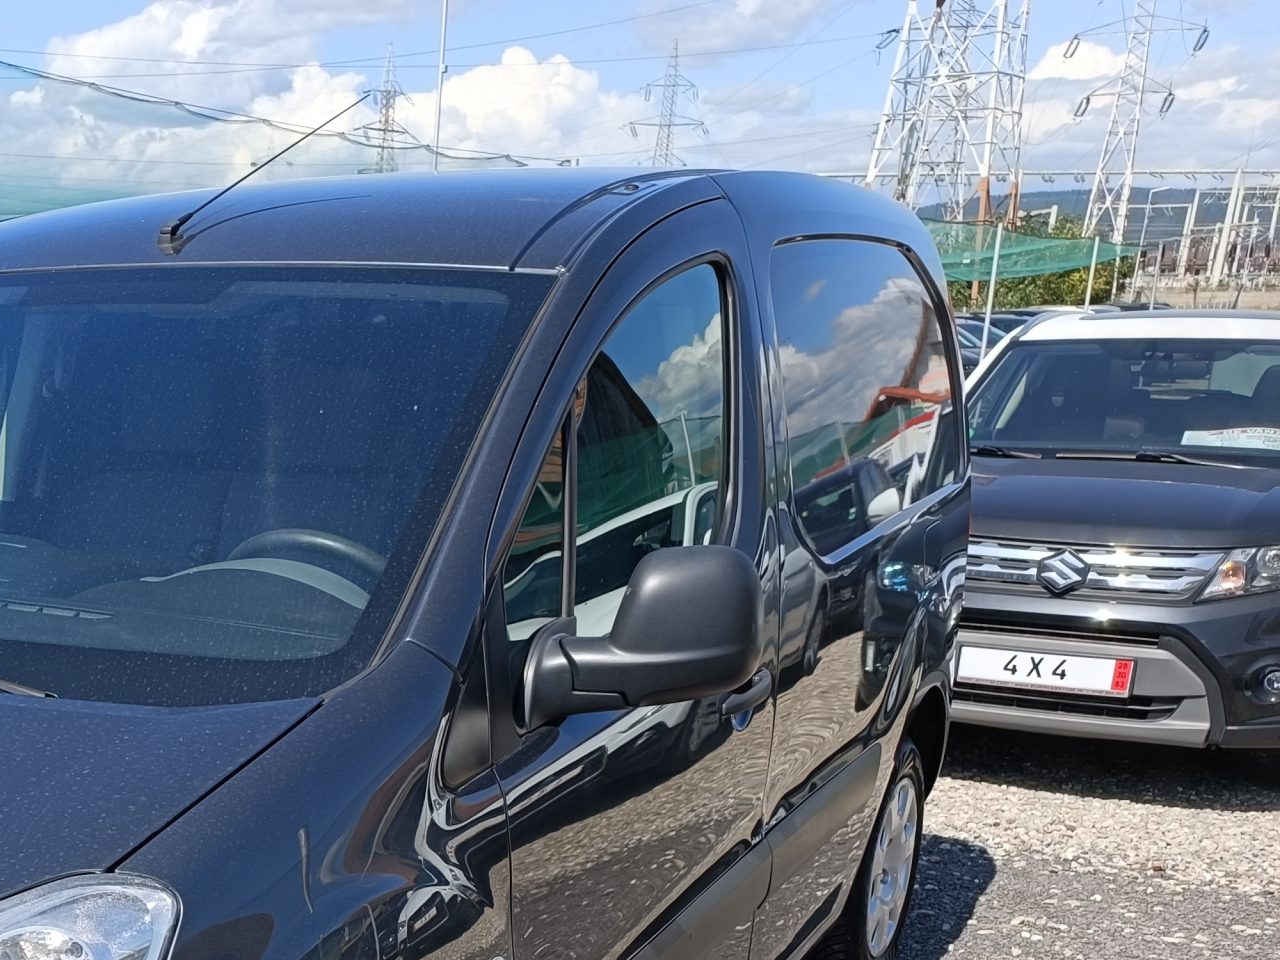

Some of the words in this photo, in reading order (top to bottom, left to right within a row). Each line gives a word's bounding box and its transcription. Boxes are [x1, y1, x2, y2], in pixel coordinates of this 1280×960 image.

[1003, 655, 1018, 675] 4
[1026, 656, 1044, 678] X
[1051, 659, 1068, 680] 4
